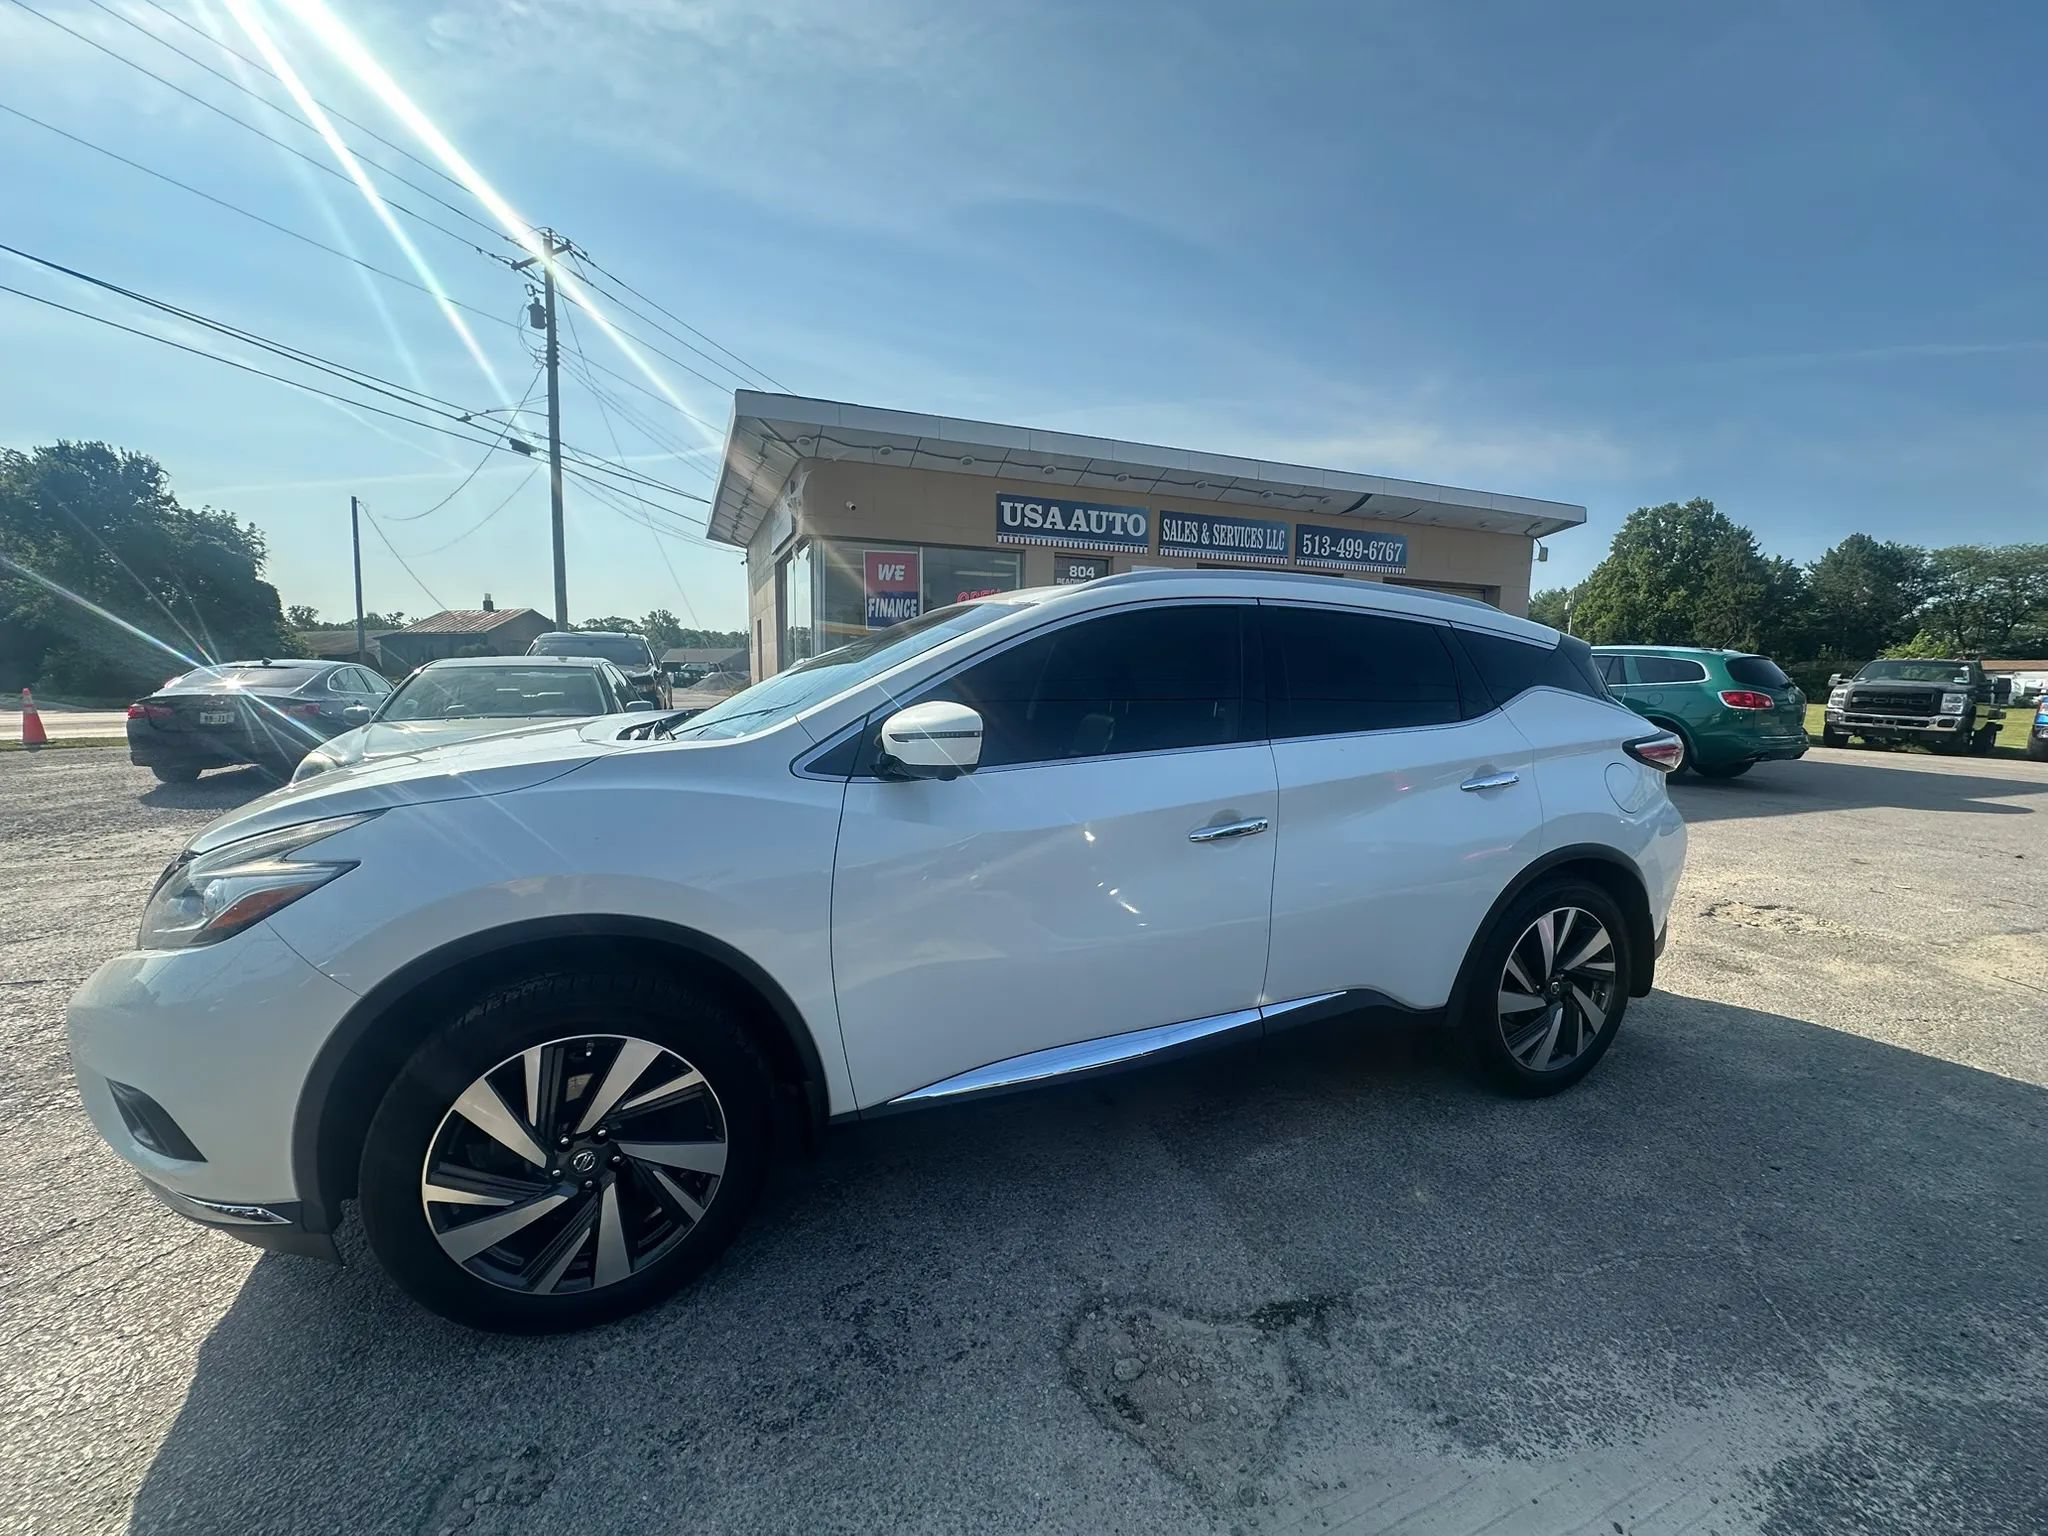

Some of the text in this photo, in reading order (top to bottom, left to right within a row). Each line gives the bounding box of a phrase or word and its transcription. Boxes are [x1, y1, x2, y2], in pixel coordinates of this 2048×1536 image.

[1001, 501, 1147, 537] USA AUTO
[1162, 518, 1285, 551] SALES & SERVICES LLC
[1302, 533, 1404, 562] 513-499-6767
[878, 563, 906, 581] WE
[1069, 565, 1096, 579] 804
[868, 598, 918, 618] FINANCE
